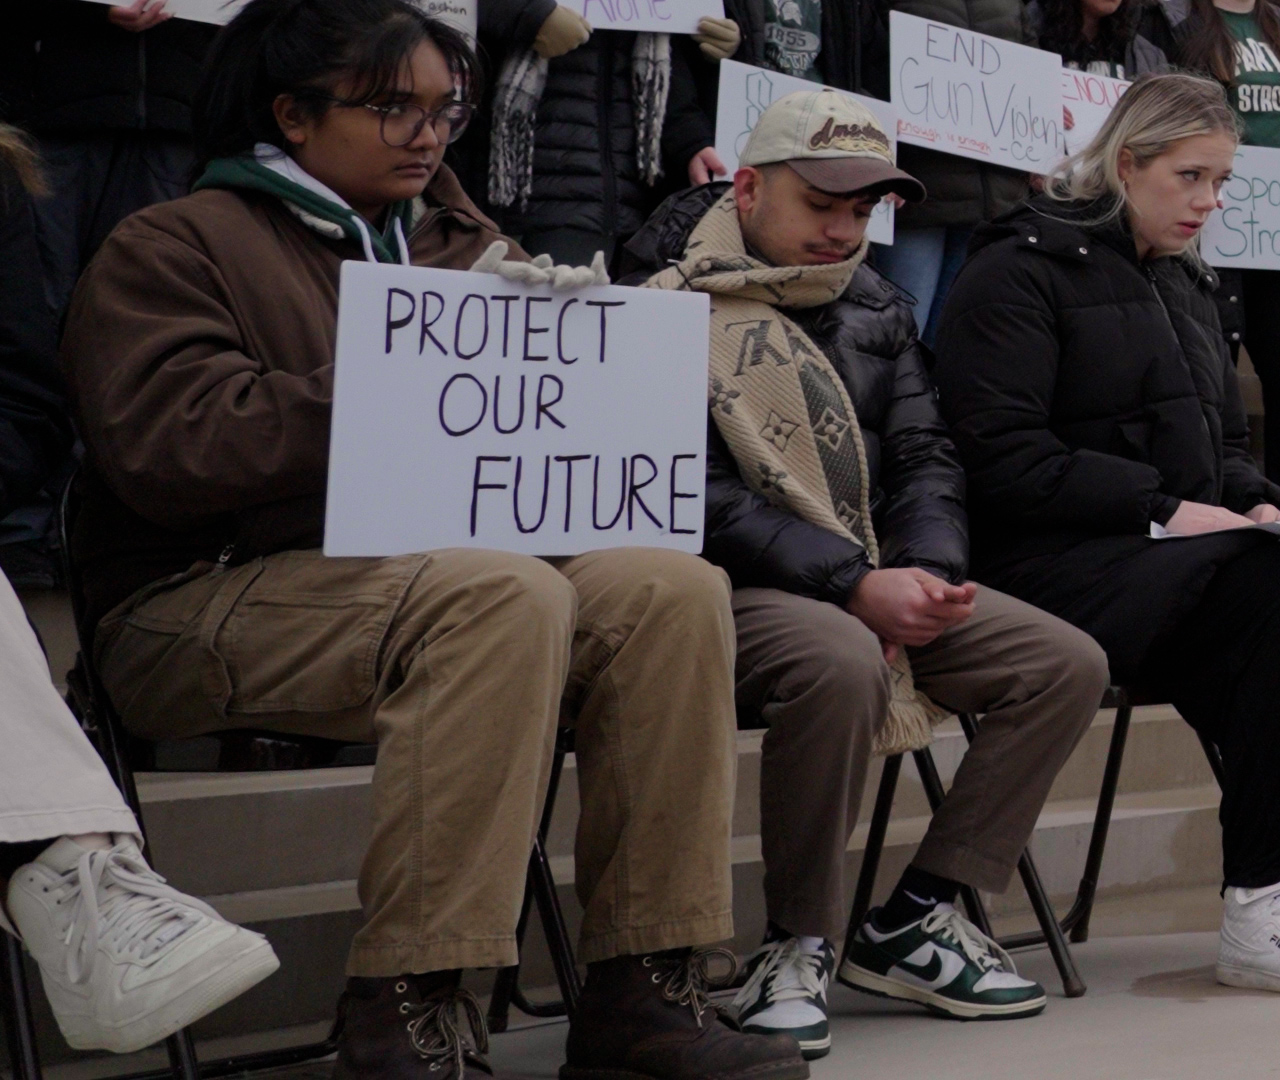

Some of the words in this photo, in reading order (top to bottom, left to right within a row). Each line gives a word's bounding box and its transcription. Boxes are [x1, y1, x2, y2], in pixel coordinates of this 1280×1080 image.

[766, 25, 806, 47] 1855
[927, 23, 1001, 75] END
[900, 57, 974, 127] Gun
[385, 287, 627, 365] PROTECT
[438, 372, 567, 437] OUR
[470, 453, 699, 537] FUTURE
